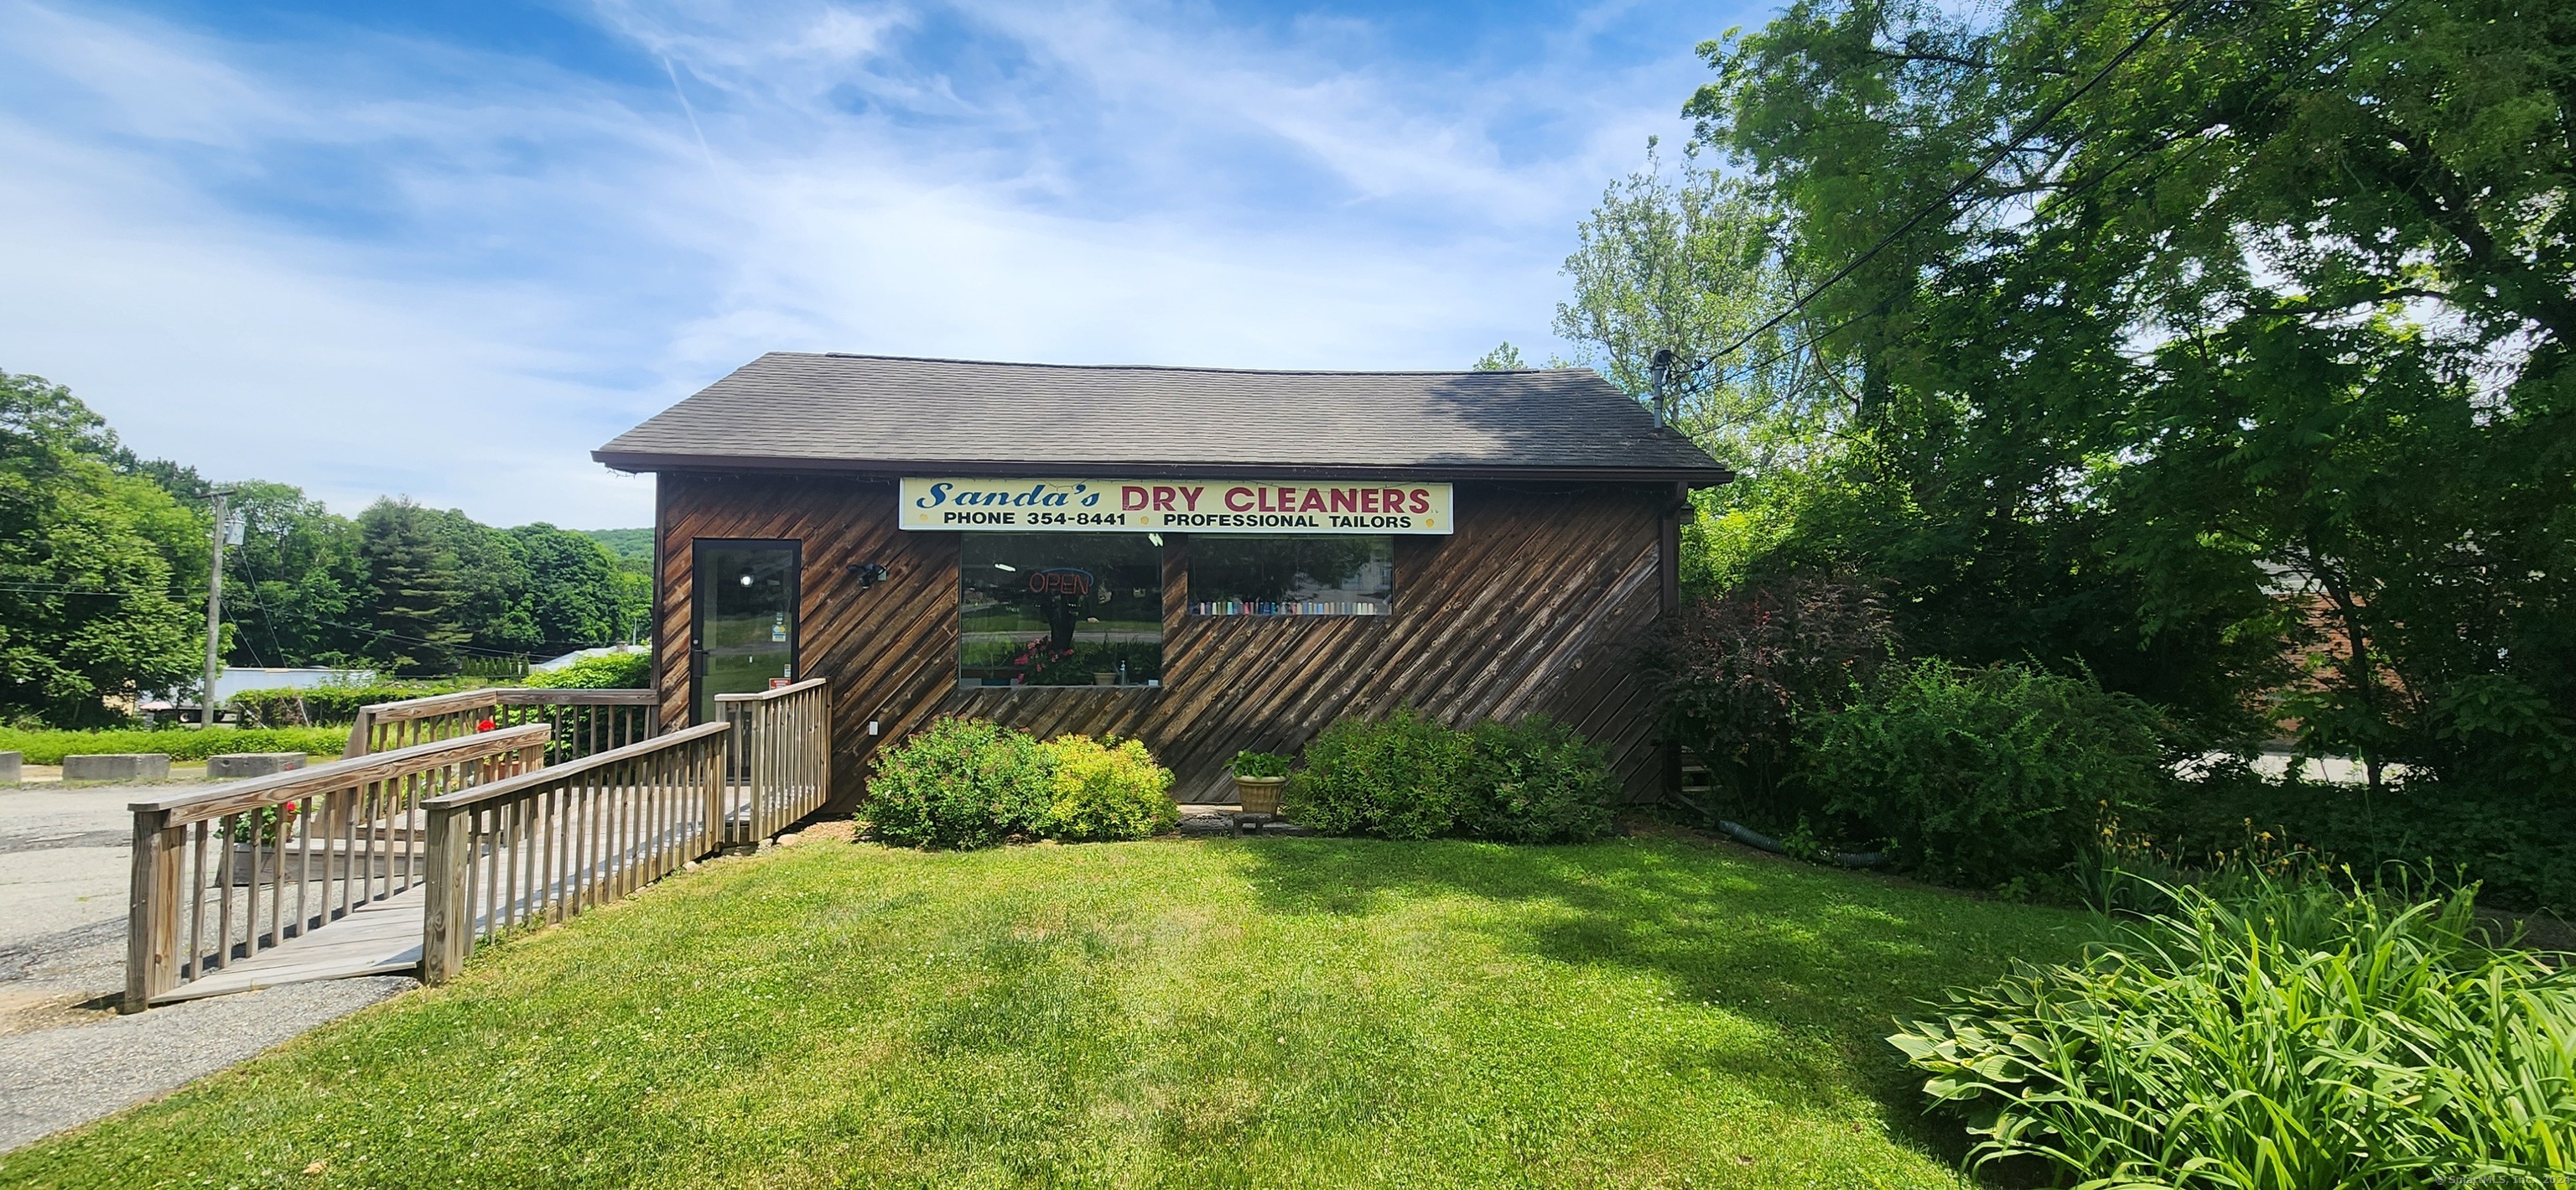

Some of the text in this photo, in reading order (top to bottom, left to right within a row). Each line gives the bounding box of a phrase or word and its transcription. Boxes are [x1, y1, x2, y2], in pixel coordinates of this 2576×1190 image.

[917, 482, 1431, 513] Sanda's DRY CLEANERS
[943, 512, 1411, 528] PHONE 354-8441 PROFESSIONAL TAILORS
[1030, 573, 1089, 595] OPEN
